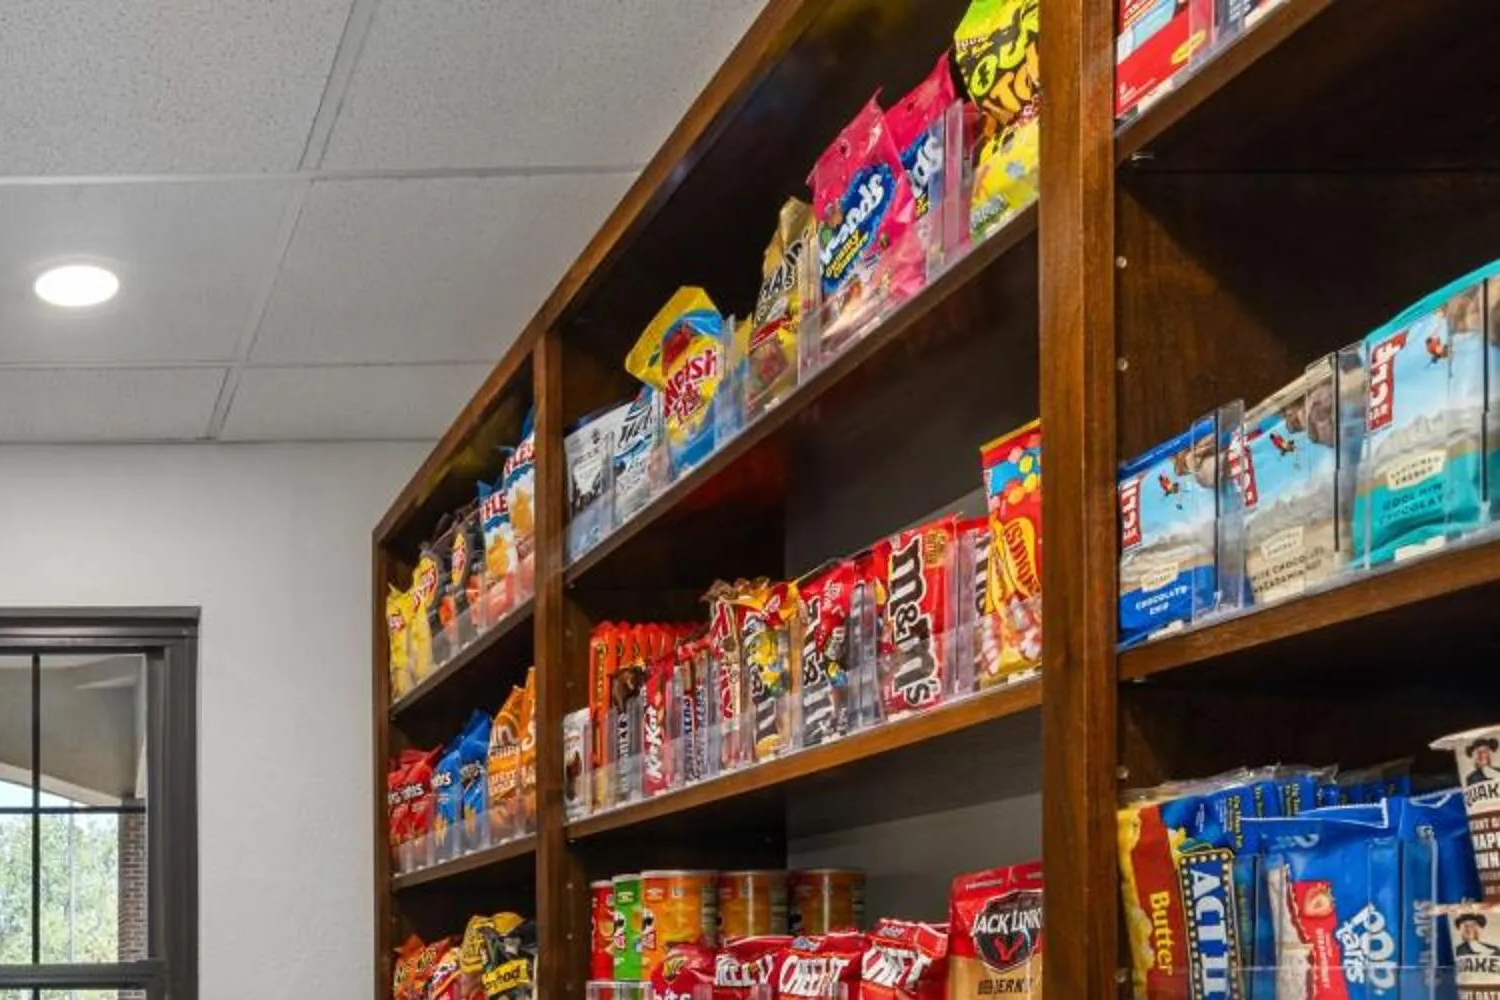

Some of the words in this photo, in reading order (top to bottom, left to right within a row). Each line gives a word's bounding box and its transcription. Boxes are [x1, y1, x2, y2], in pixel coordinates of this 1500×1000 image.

[970, 911, 1012, 938] JACK
[1150, 890, 1175, 977] Butter
[1190, 868, 1228, 945] ACT
